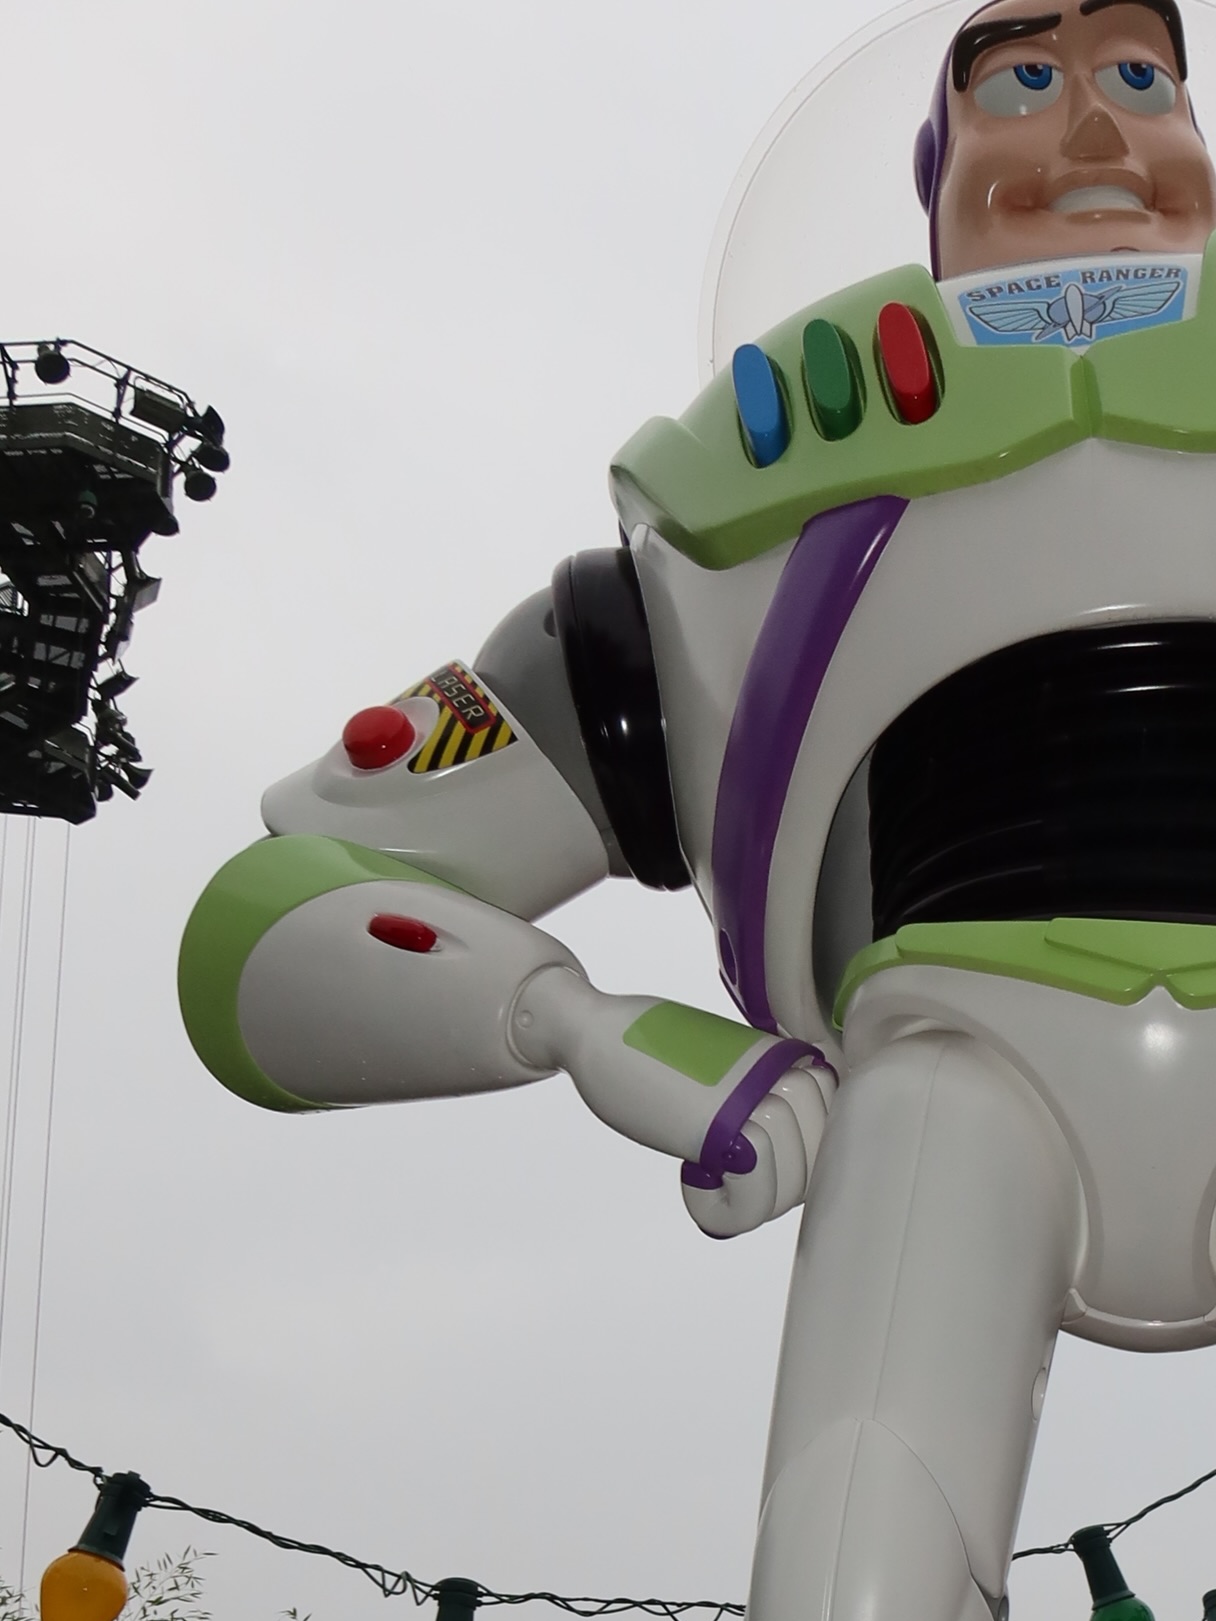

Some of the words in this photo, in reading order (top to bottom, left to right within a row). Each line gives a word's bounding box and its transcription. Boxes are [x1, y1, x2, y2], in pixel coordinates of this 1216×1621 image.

[966, 274, 1062, 302] SPACE
[1081, 267, 1182, 285] RANGER
[430, 670, 486, 721] LASER
